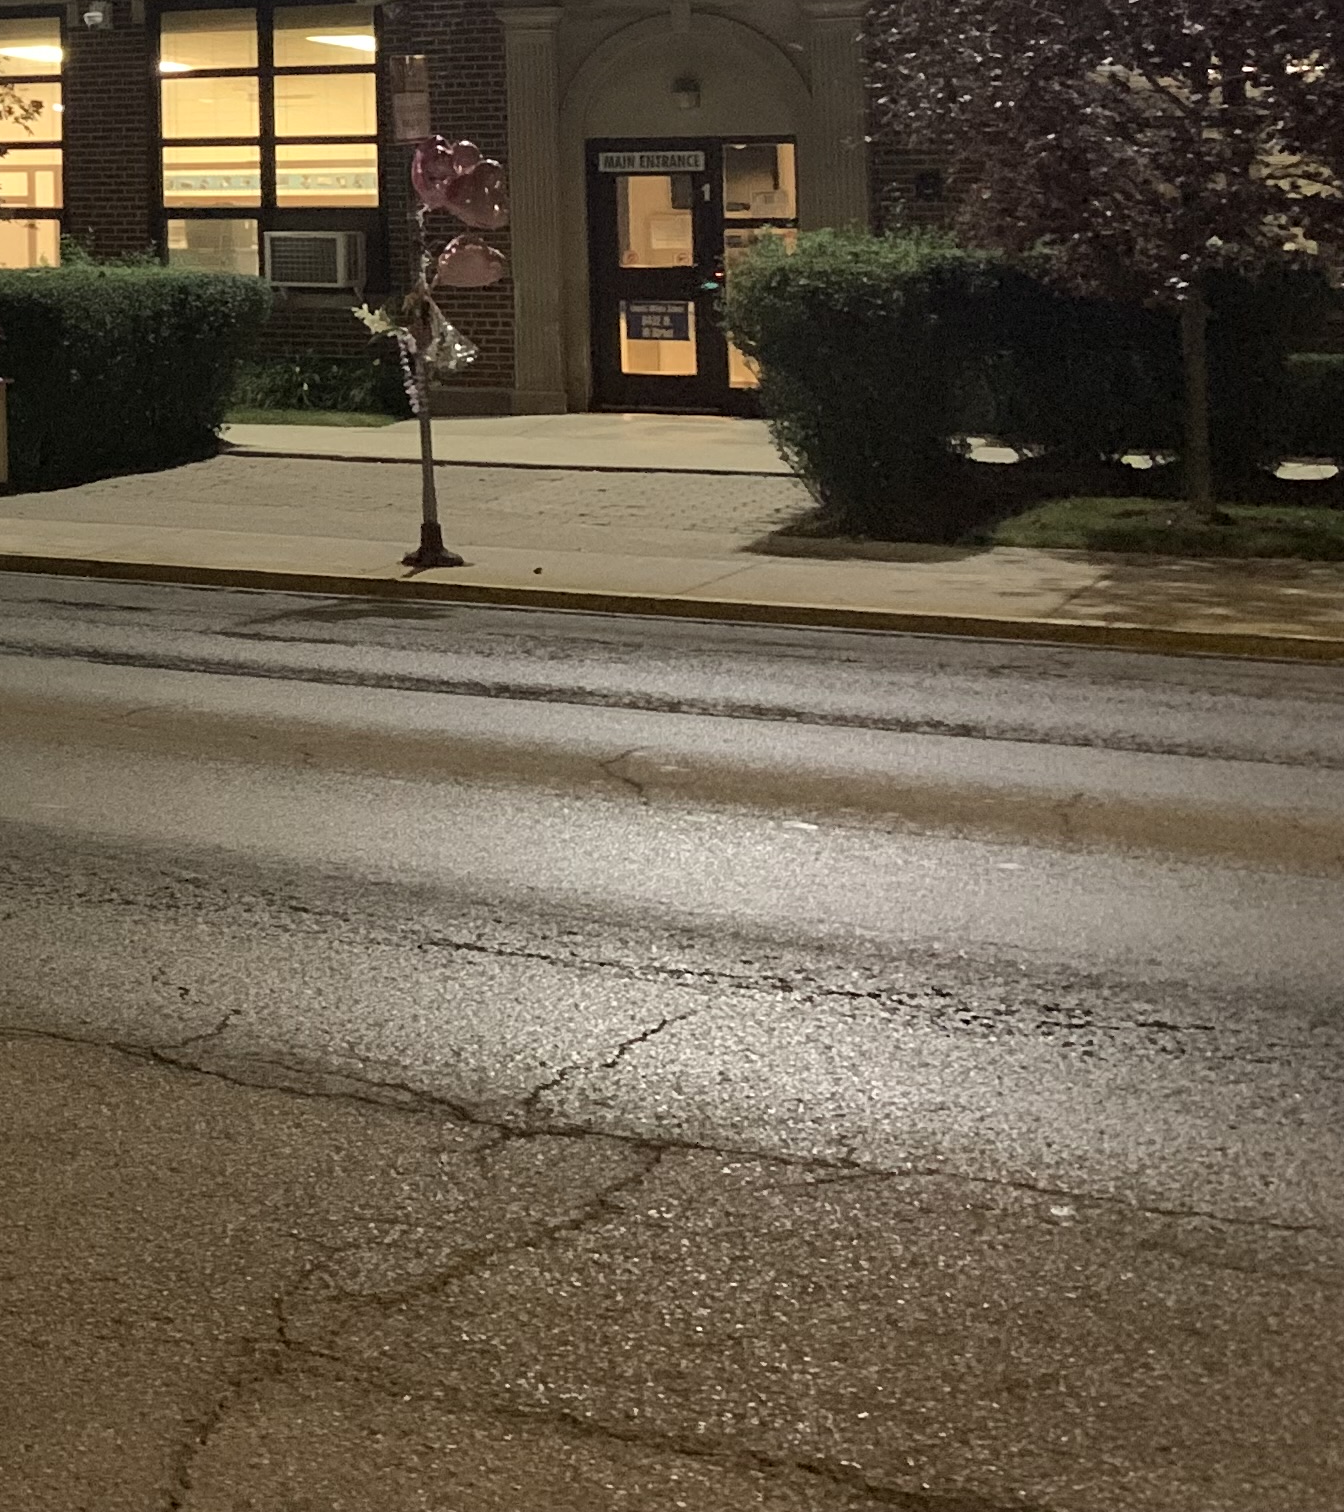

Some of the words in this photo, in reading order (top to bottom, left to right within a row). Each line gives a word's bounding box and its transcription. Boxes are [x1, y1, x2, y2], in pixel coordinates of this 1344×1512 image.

[603, 155, 635, 168] MAIN
[639, 154, 700, 168] ENTRANCE
[701, 183, 711, 202] 1
